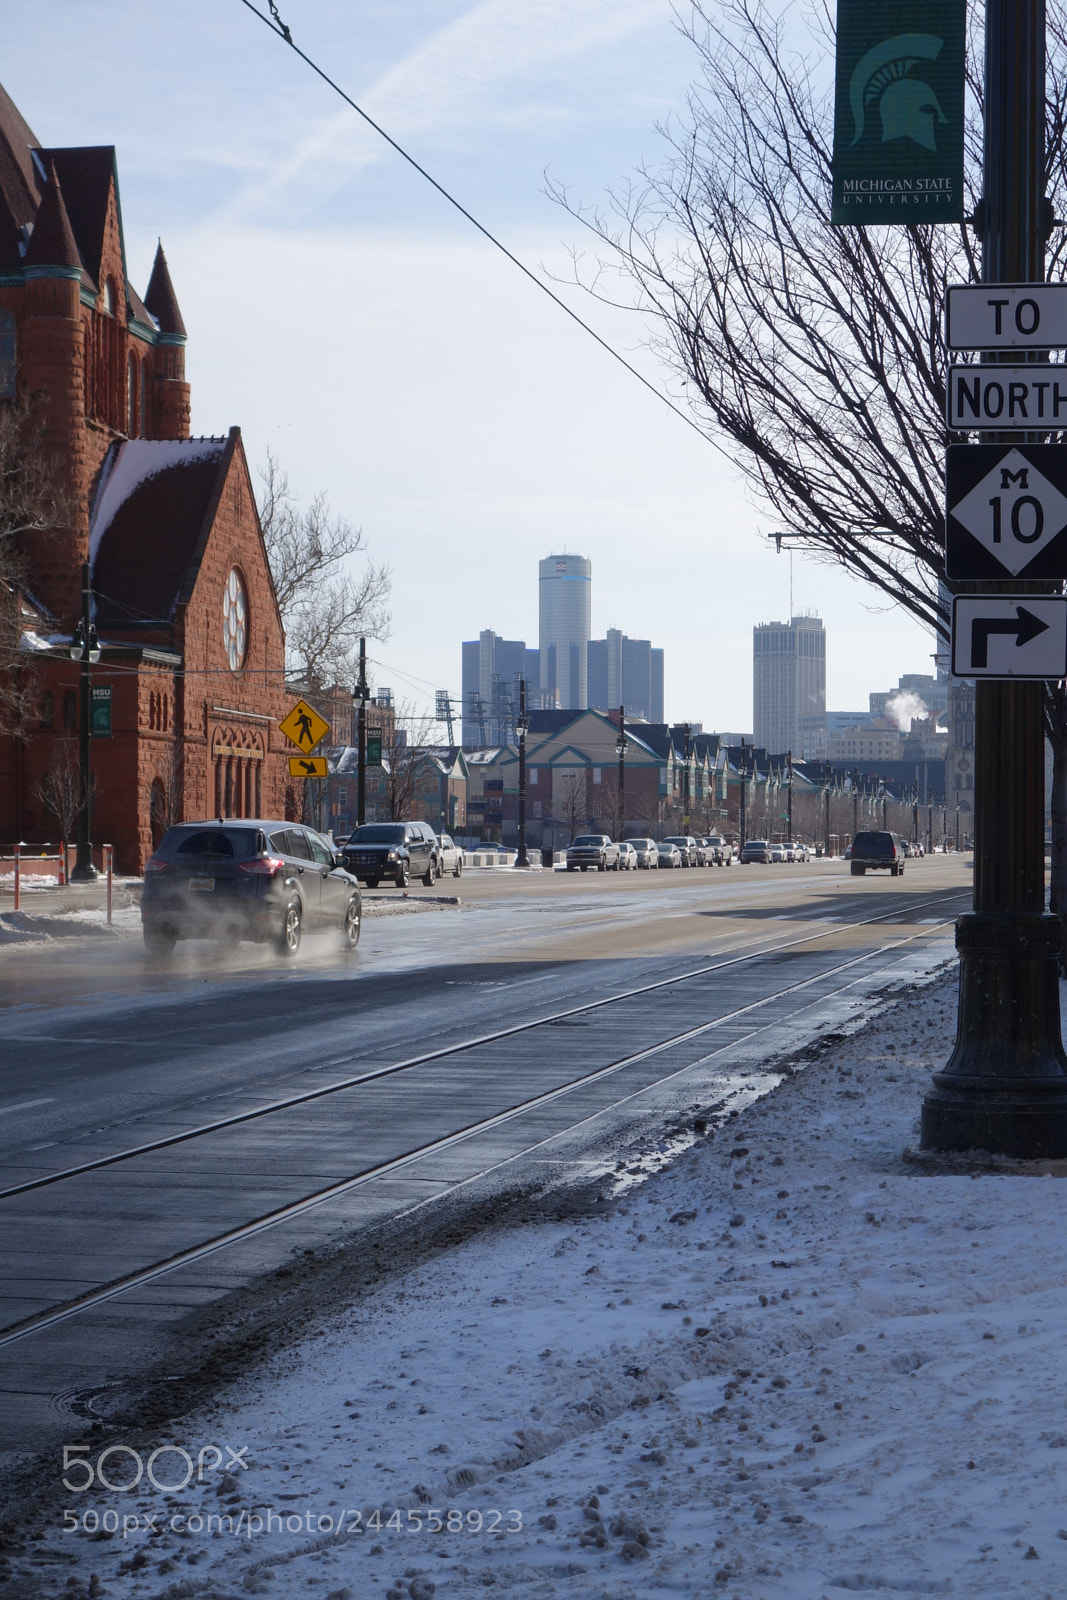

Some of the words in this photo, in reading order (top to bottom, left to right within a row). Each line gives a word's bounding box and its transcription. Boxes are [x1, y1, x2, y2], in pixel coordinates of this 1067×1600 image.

[843, 179, 912, 191] MICHIGAN
[916, 177, 953, 190] STATE
[843, 193, 953, 204] UNIVERSITY
[987, 298, 1041, 335] TO
[1000, 467, 1029, 489] M
[989, 495, 1044, 544] 10
